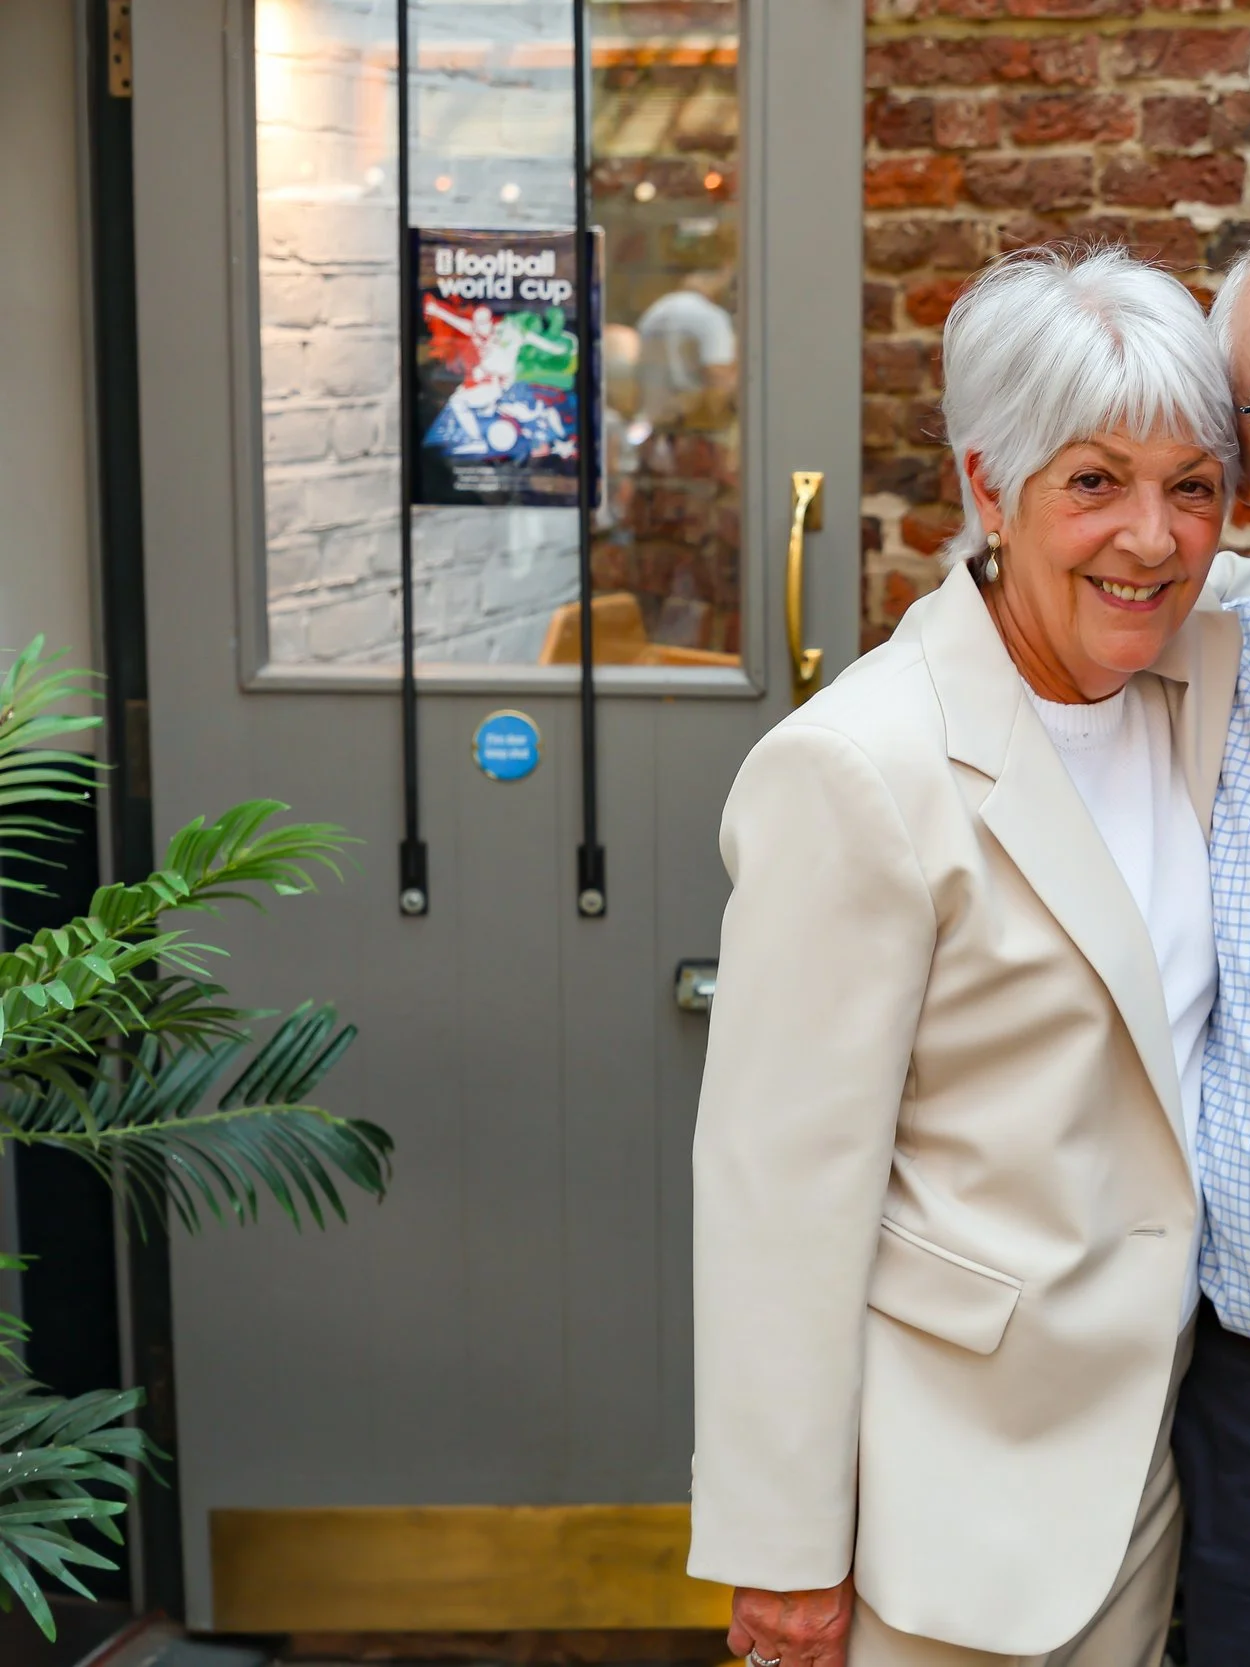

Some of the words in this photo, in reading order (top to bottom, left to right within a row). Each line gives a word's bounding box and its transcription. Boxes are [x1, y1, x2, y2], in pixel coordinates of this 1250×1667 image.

[455, 248, 556, 277] football
[437, 276, 513, 299] world
[519, 279, 573, 306] cup
